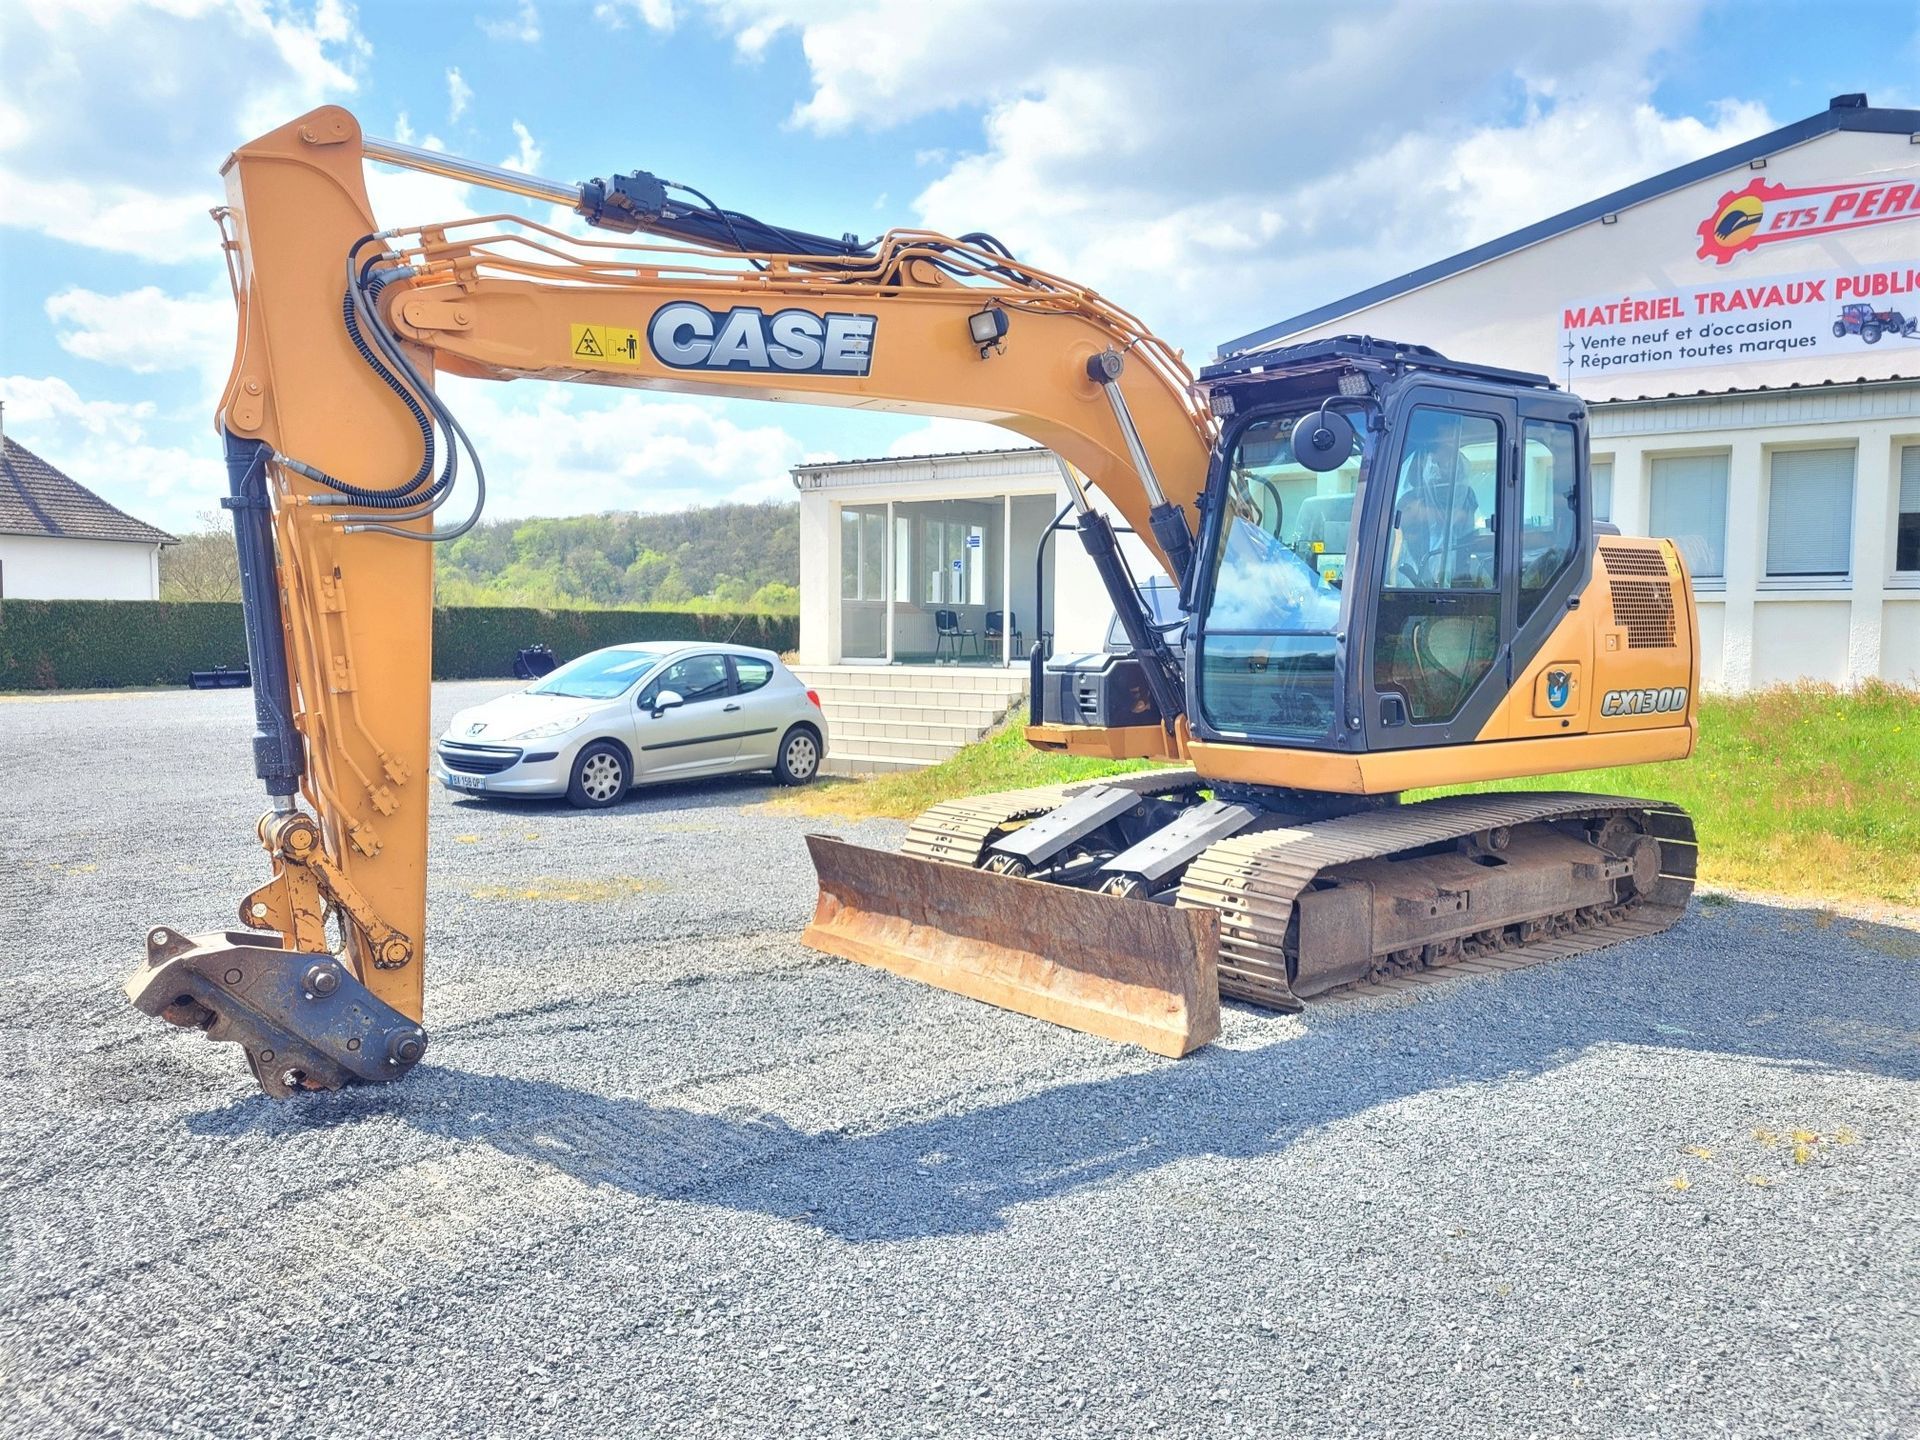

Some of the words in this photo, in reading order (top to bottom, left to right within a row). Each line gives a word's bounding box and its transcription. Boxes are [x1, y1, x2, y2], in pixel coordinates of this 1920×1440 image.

[1769, 206, 1819, 231] ETS
[1823, 184, 1920, 223] PER
[1564, 296, 1685, 329] MATÉRIEL
[1694, 280, 1826, 315] TRAVAUX
[648, 302, 875, 371] CASE
[1580, 348, 1673, 369] Réparation
[1678, 344, 1733, 359] toutes
[1739, 334, 1817, 353] marques
[1581, 335, 1626, 350] Vente
[1632, 328, 1669, 345] neuf
[1675, 327, 1693, 341] et
[1699, 318, 1793, 338] d'occasion
[1601, 687, 1688, 716] CX130D
